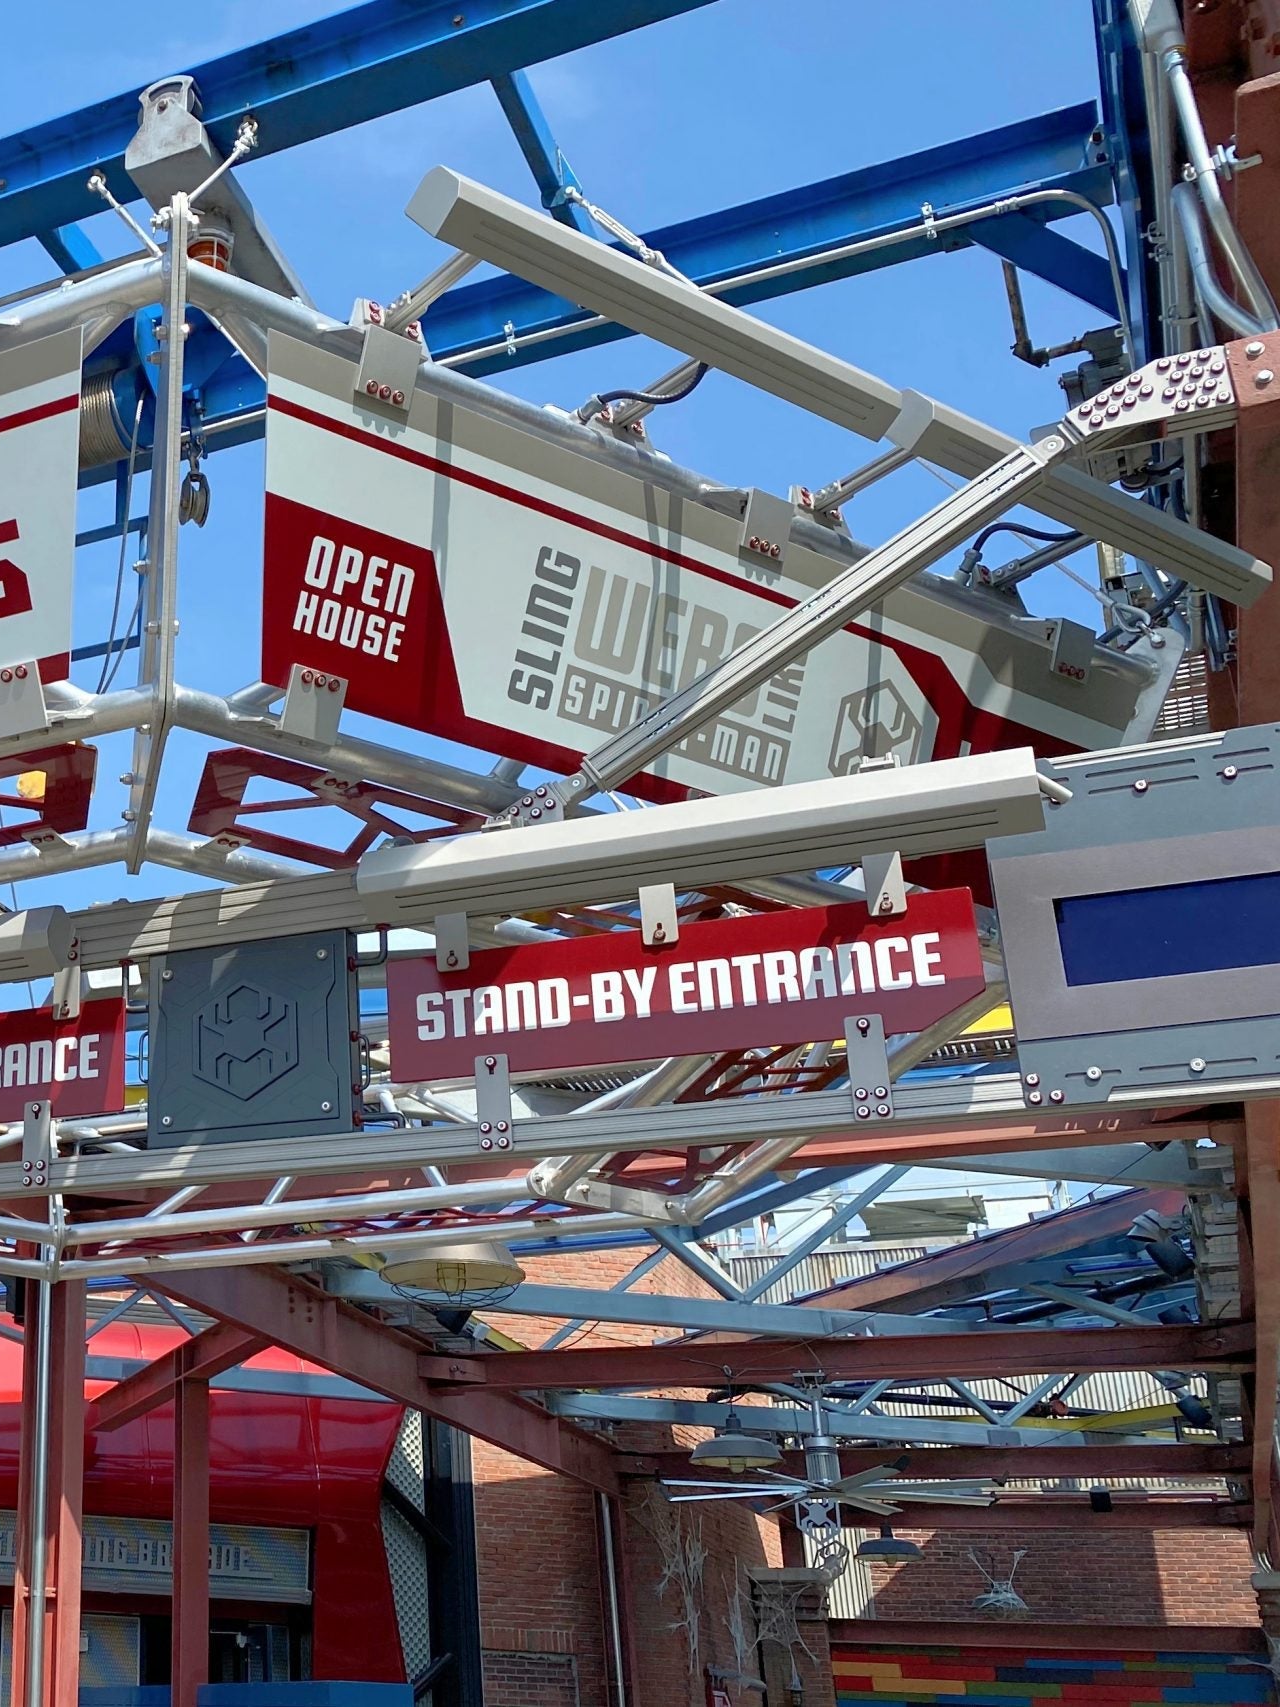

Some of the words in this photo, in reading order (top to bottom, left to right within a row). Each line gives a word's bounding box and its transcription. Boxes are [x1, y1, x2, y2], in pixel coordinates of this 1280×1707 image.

[304, 535, 415, 618] OPEN
[292, 590, 406, 663] HOUSE
[507, 546, 582, 711] SLING
[564, 674, 783, 781] SPID-MAN
[762, 645, 810, 734] LIK
[416, 965, 658, 1042] STAND-BY
[669, 932, 946, 1015] ENTRANCE
